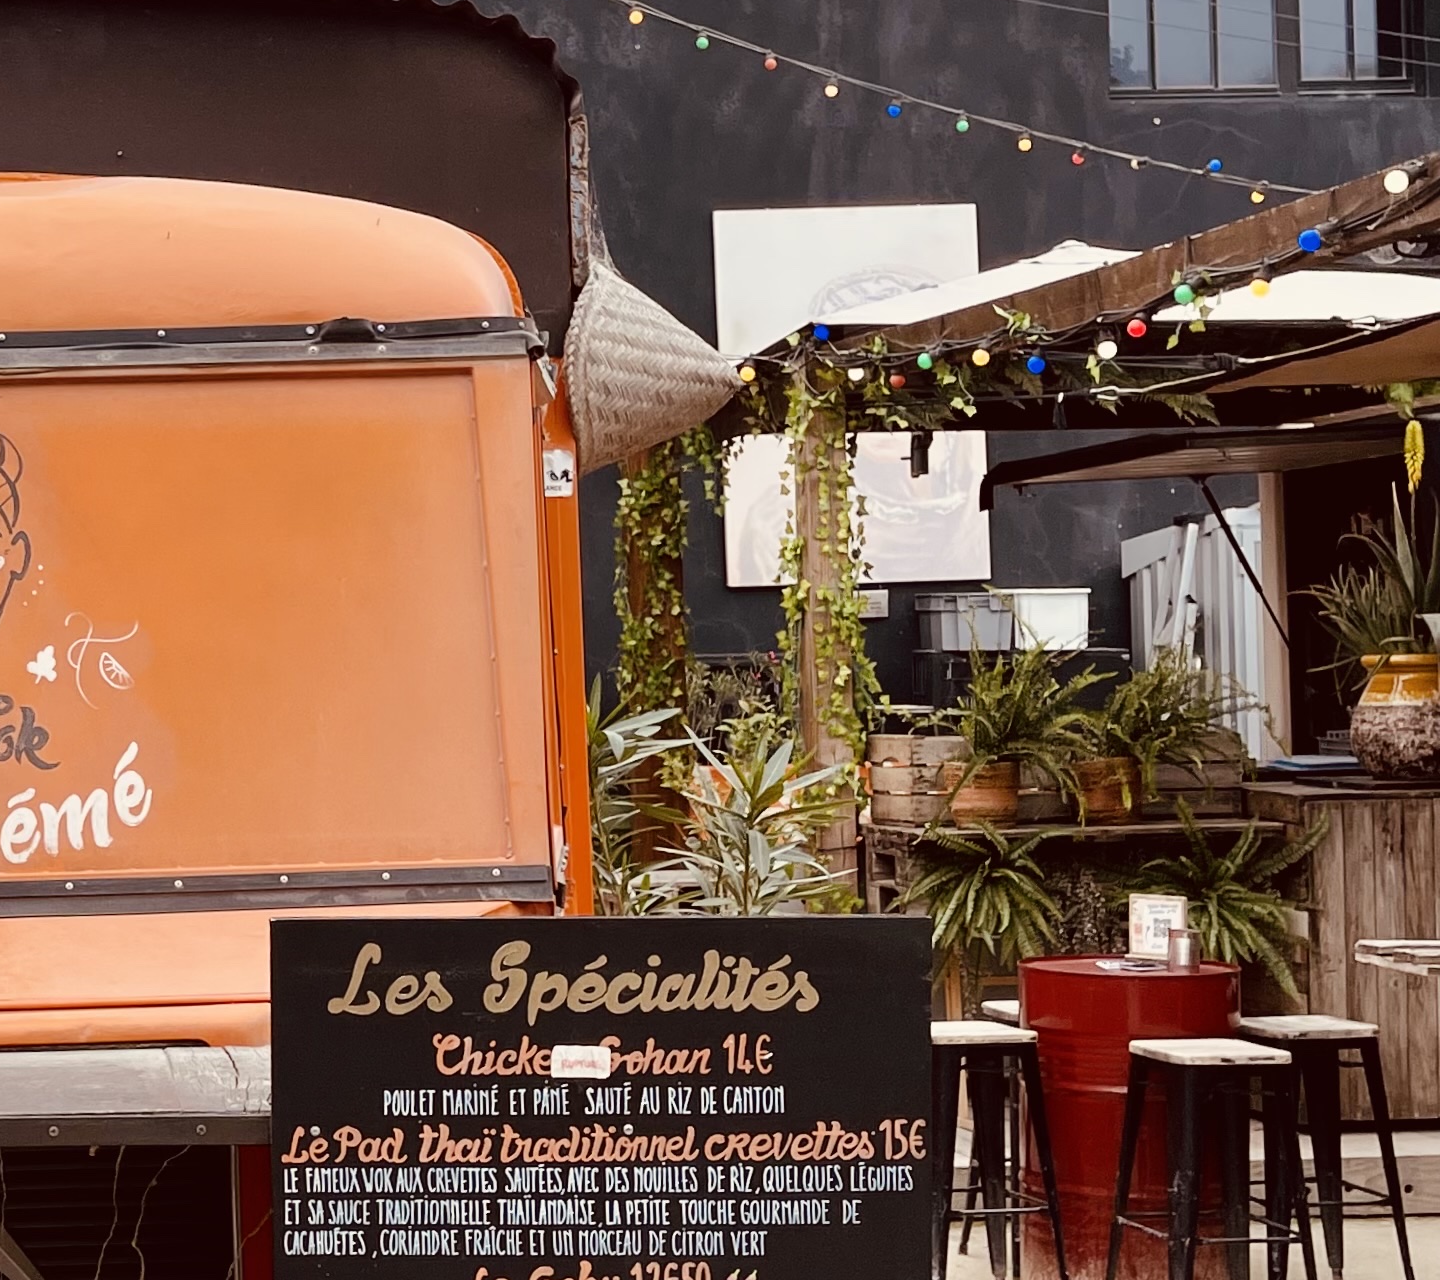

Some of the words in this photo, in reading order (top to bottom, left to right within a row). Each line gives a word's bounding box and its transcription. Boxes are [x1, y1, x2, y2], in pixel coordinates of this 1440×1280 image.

[327, 942, 453, 1016] Les
[483, 940, 820, 1027] Spécialités
[433, 1033, 551, 1076] Chicke
[383, 1089, 436, 1117] POULET
[509, 1088, 527, 1116] ET
[584, 1081, 632, 1115] SAUTÉ
[639, 1085, 660, 1115] AU
[700, 1085, 718, 1115] DE
[723, 1085, 785, 1115] CANTON
[333, 1125, 407, 1163] Pad
[419, 1123, 497, 1163] thaï
[500, 1122, 699, 1163] traditionnel
[704, 1120, 875, 1161] crevettes
[879, 1119, 926, 1160] 15€
[283, 1167, 299, 1194] LE
[305, 1166, 361, 1194] FAMEUX
[395, 1166, 424, 1193] AUX
[426, 1166, 498, 1194] CREVETTES
[566, 1165, 600, 1193] AVEC
[605, 1166, 630, 1193] DES
